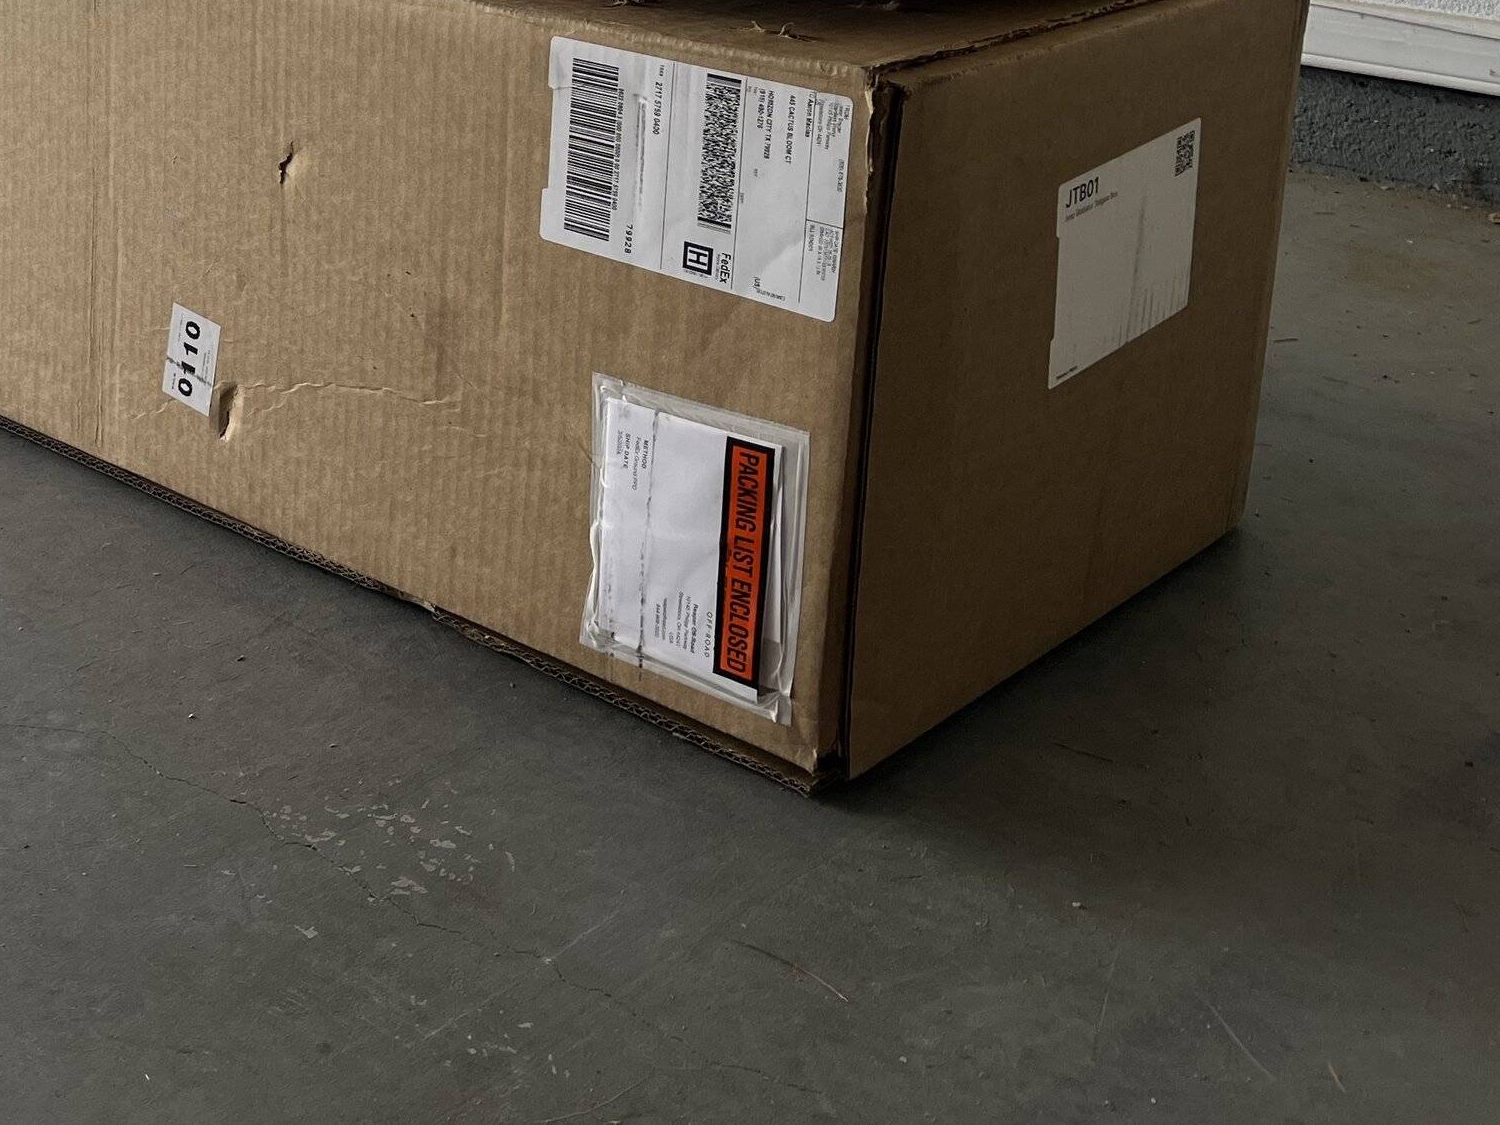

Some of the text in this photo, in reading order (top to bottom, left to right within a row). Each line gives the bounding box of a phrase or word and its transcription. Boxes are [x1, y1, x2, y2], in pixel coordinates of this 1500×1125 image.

[653, 80, 663, 99] 2717
[762, 89, 775, 160] HORIZON CITY TX 79928
[786, 105, 796, 132] CACTUS
[784, 131, 794, 157] BLOOM
[784, 155, 792, 164] CT
[1065, 177, 1100, 209] JTB01
[623, 222, 633, 255] 79928
[718, 251, 731, 285] FedEx
[178, 320, 201, 397] 0110
[640, 438, 649, 470] METHOD
[723, 450, 763, 675] PACKING LIST ENCLOSED
[702, 610, 713, 659] OFF-ROAD
